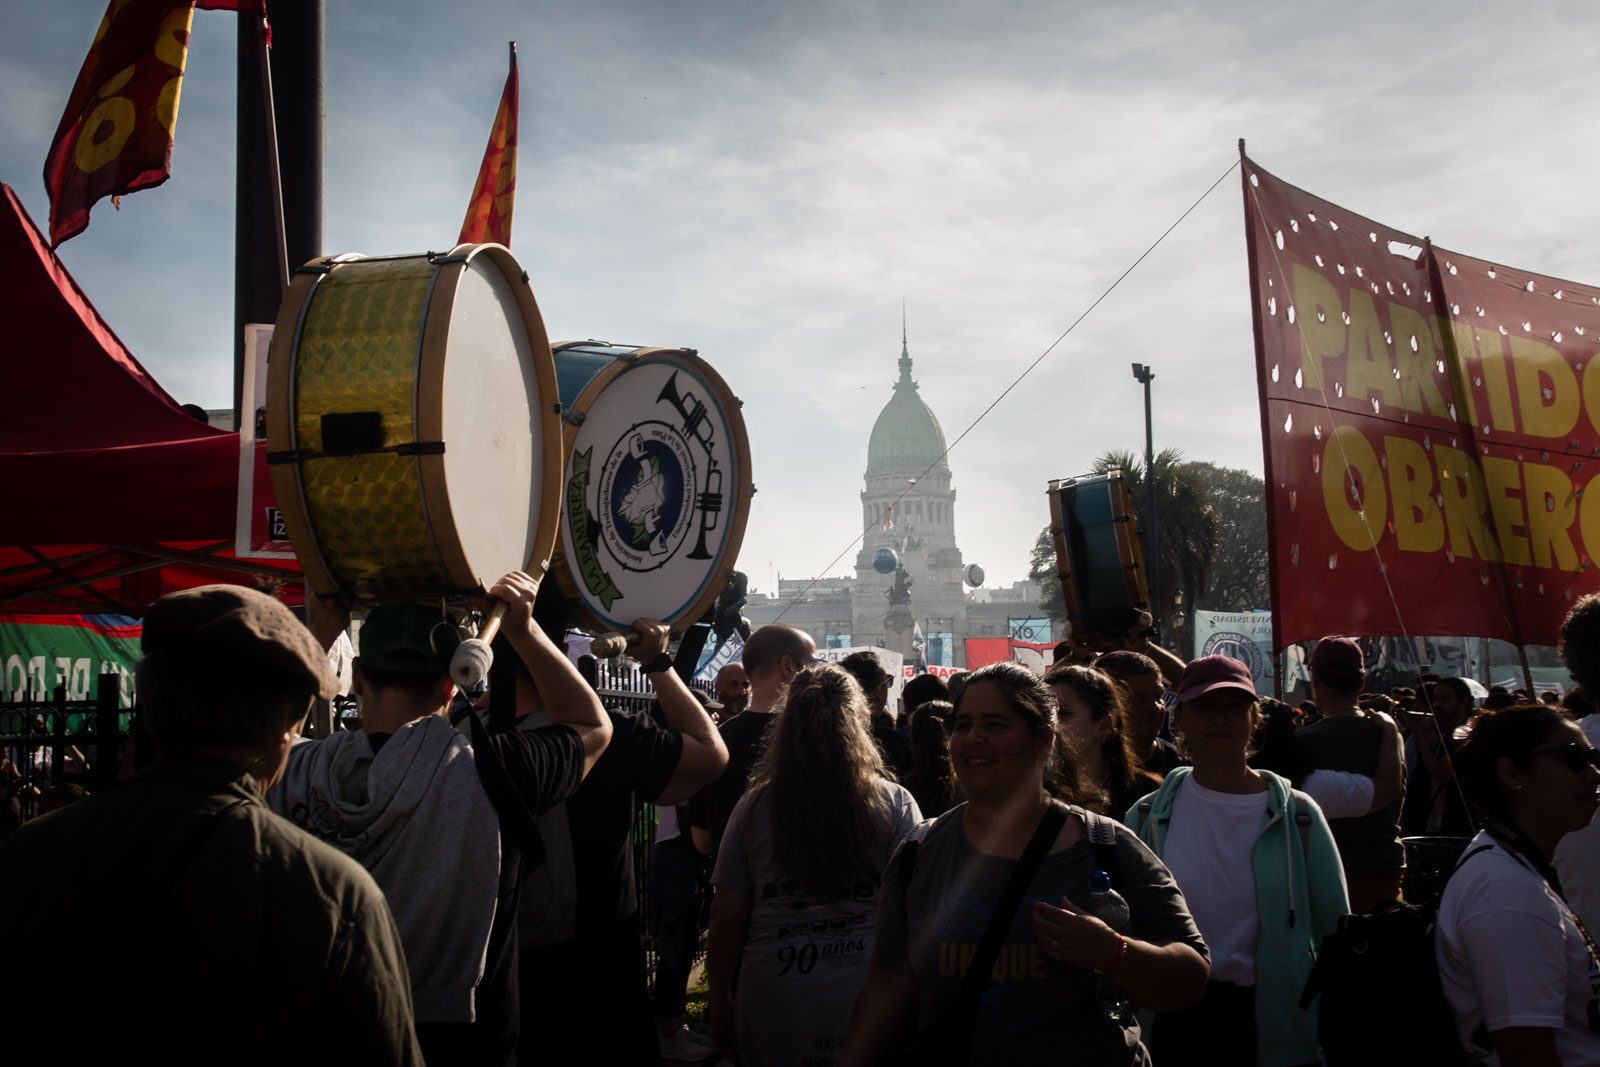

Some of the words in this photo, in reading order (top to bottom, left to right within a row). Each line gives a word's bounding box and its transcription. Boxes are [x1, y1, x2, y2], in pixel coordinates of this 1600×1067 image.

[680, 451, 692, 487] Nacional
[571, 480, 591, 563] RAMIREZ
[588, 566, 602, 592] LA
[778, 942, 819, 976] 90
[822, 938, 865, 956] años
[937, 940, 1049, 984] UNQUE
